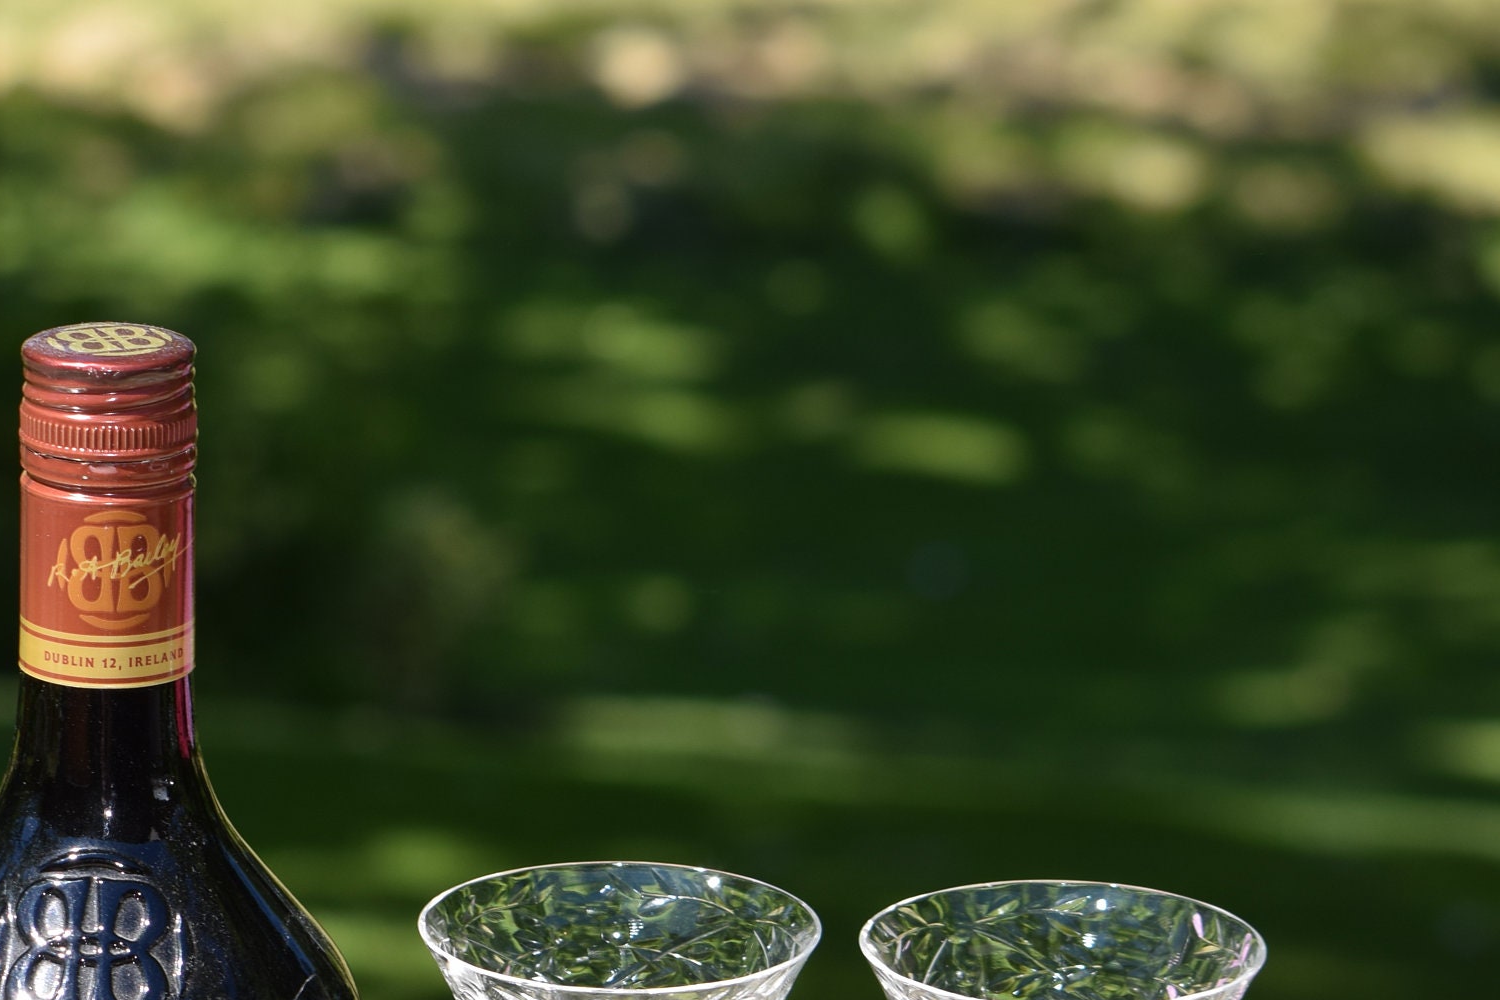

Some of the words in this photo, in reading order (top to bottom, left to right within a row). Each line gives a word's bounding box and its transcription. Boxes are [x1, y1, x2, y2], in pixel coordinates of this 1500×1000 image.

[44, 650, 95, 668] DUBLIN
[102, 657, 123, 671] 12,
[129, 647, 185, 668] IRELAND
